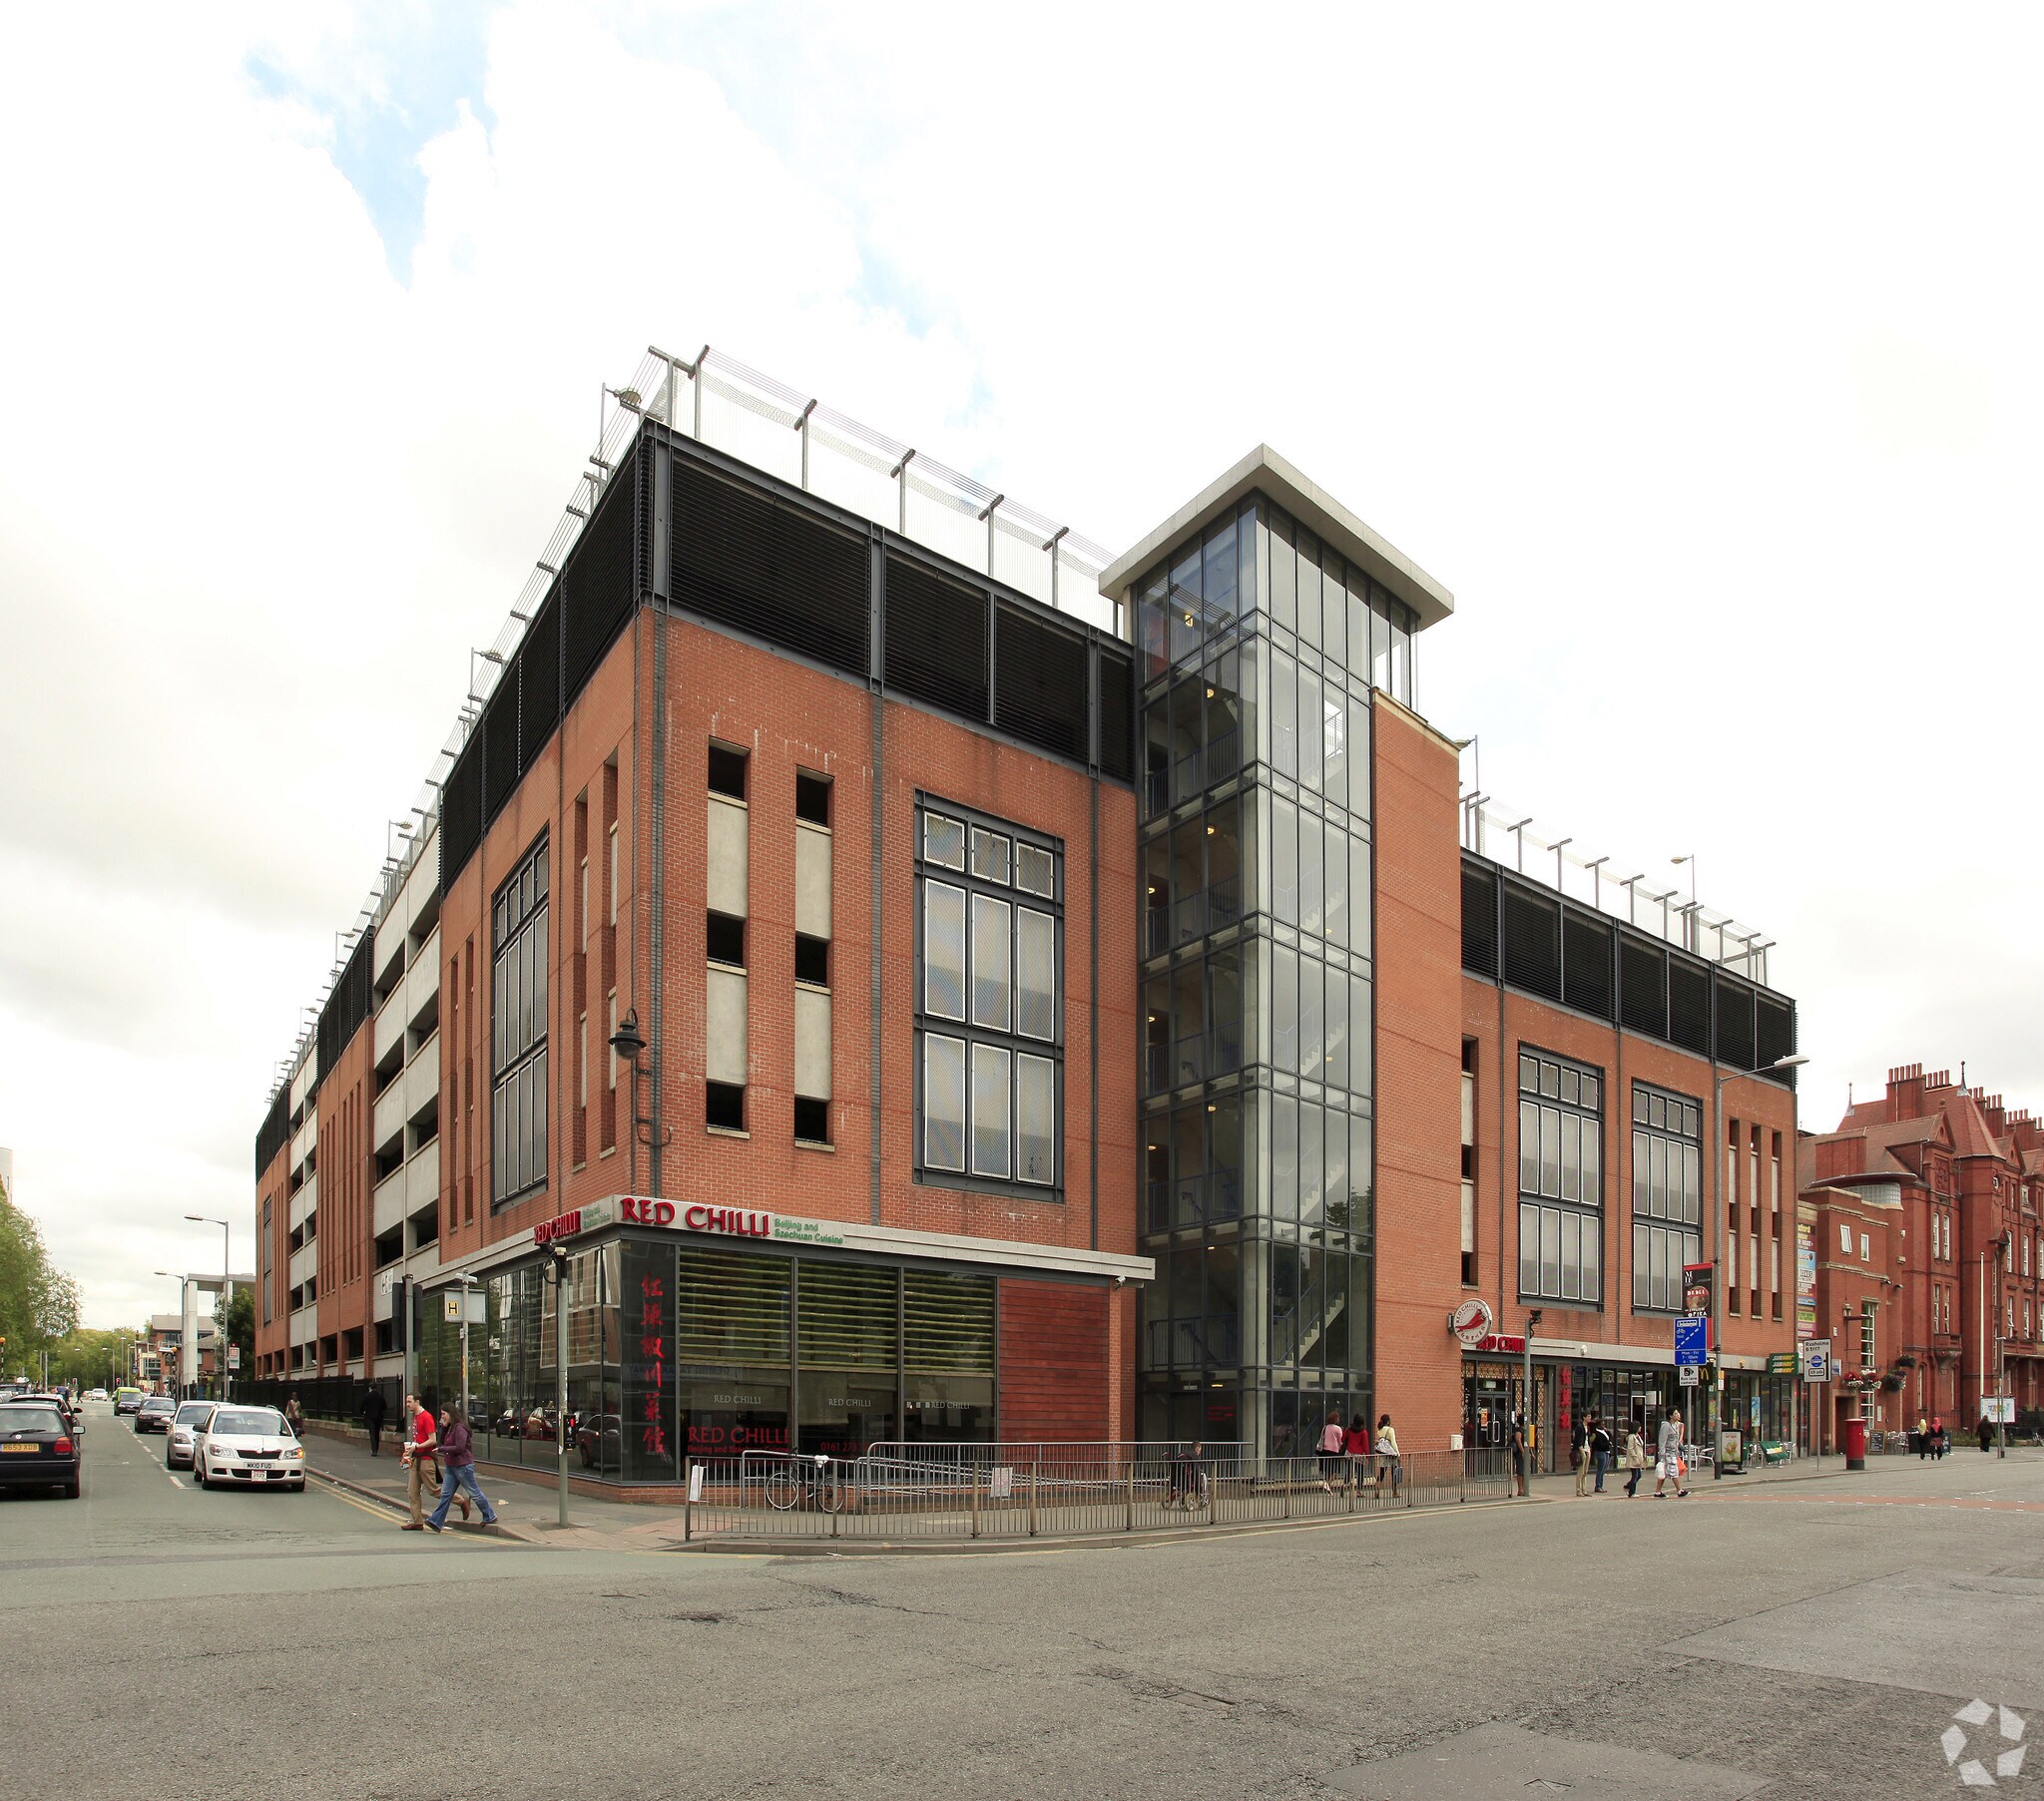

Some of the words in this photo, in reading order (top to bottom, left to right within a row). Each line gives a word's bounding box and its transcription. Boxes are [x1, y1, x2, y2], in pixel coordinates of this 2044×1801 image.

[620, 1197, 676, 1225] RED
[685, 1205, 770, 1236] CHILLI
[550, 1210, 581, 1239] CHILLI
[774, 1218, 801, 1231] Beijing
[803, 1222, 818, 1231] and
[773, 1228, 812, 1241] Szechuan
[814, 1233, 843, 1245] Cuisine
[448, 1302, 458, 1314] H
[714, 1394, 732, 1403] RED
[734, 1395, 762, 1404] CHILLI
[688, 1426, 725, 1444] RED
[730, 1427, 789, 1444] CHILLI
[820, 1442, 839, 1452] 0161
